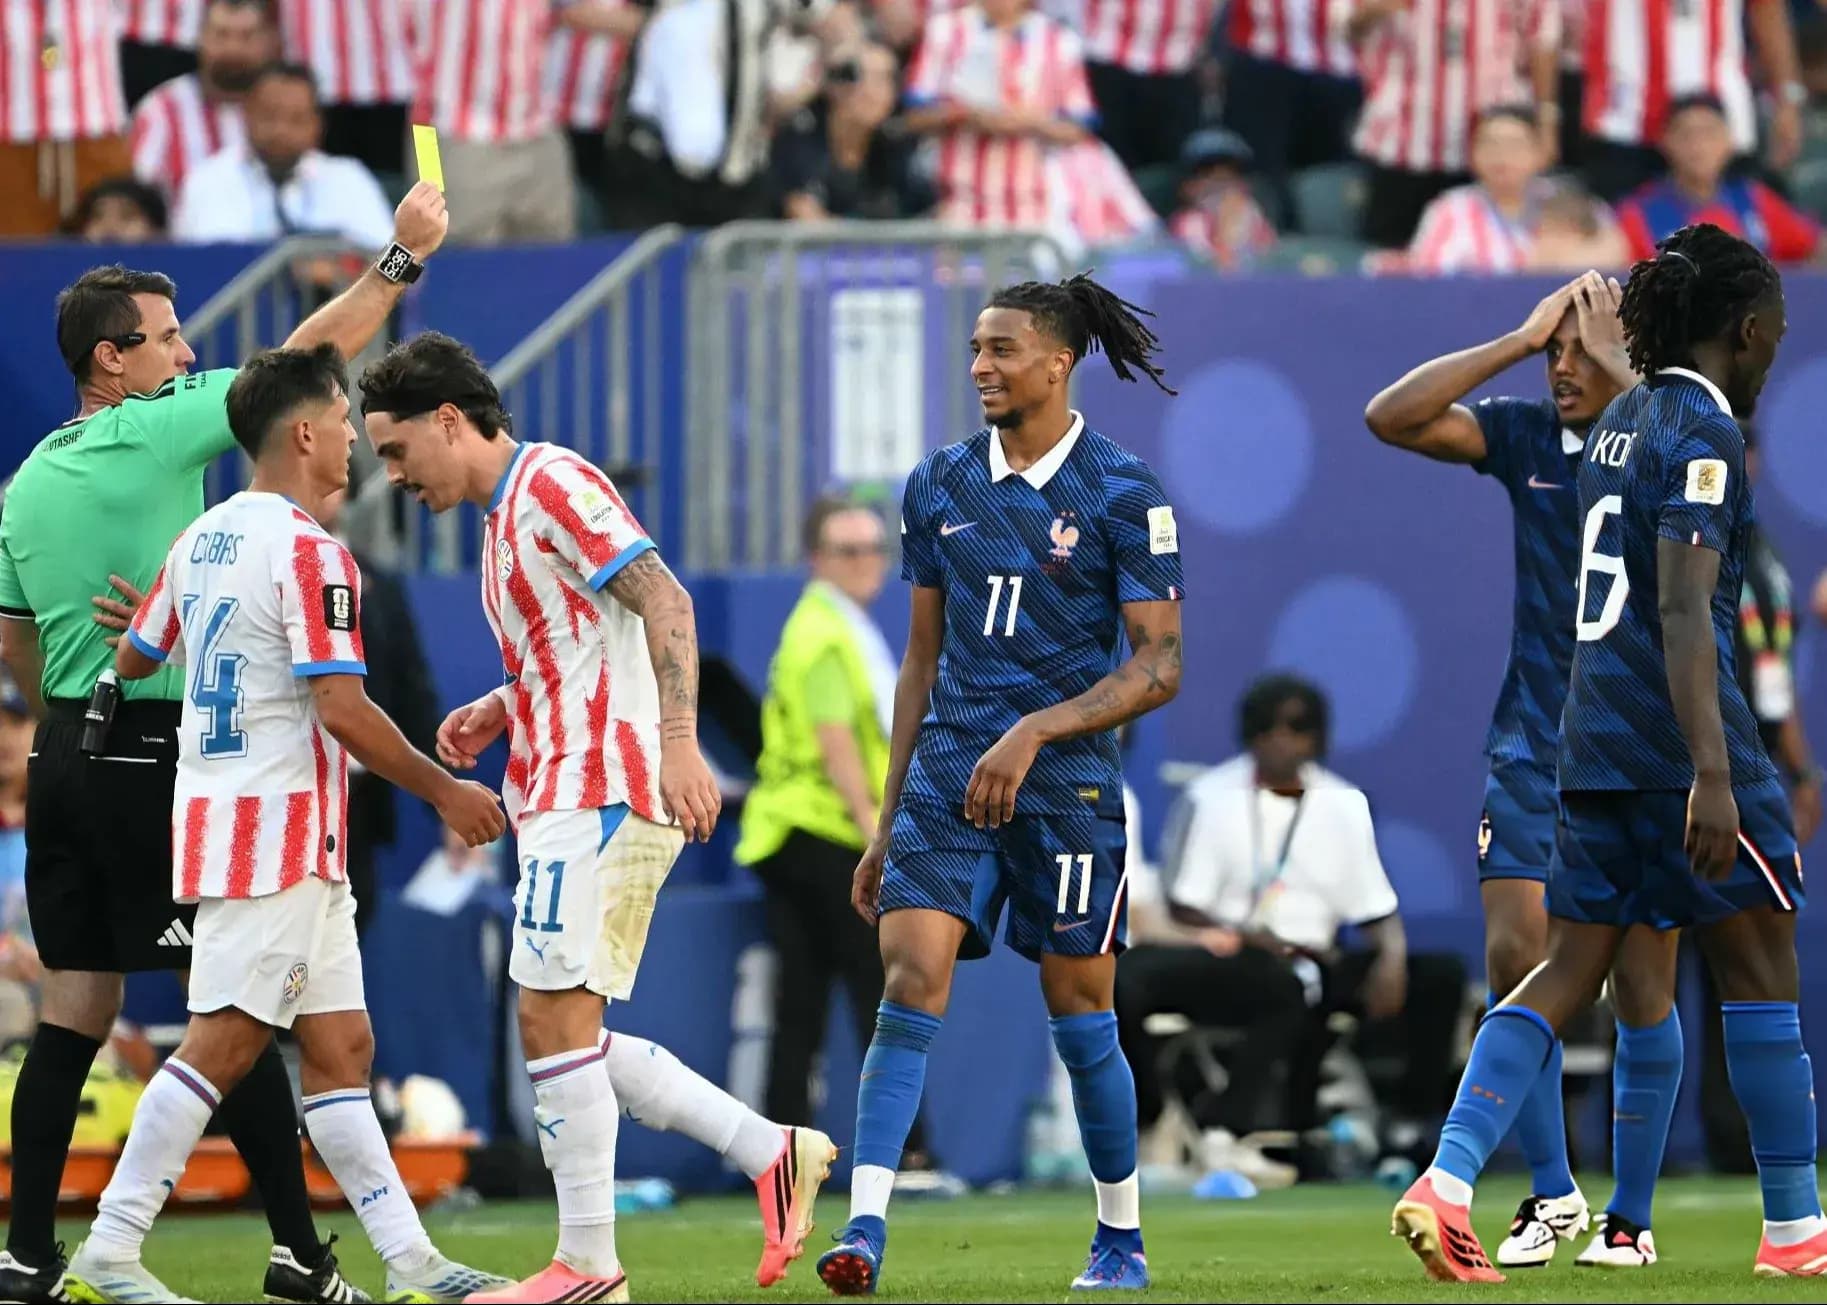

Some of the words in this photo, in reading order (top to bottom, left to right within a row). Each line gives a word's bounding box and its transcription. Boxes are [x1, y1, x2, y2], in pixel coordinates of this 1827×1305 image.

[1576, 494, 1631, 641] 6
[983, 575, 1022, 637] 11
[520, 859, 567, 933] 11
[1055, 853, 1094, 915] 11
